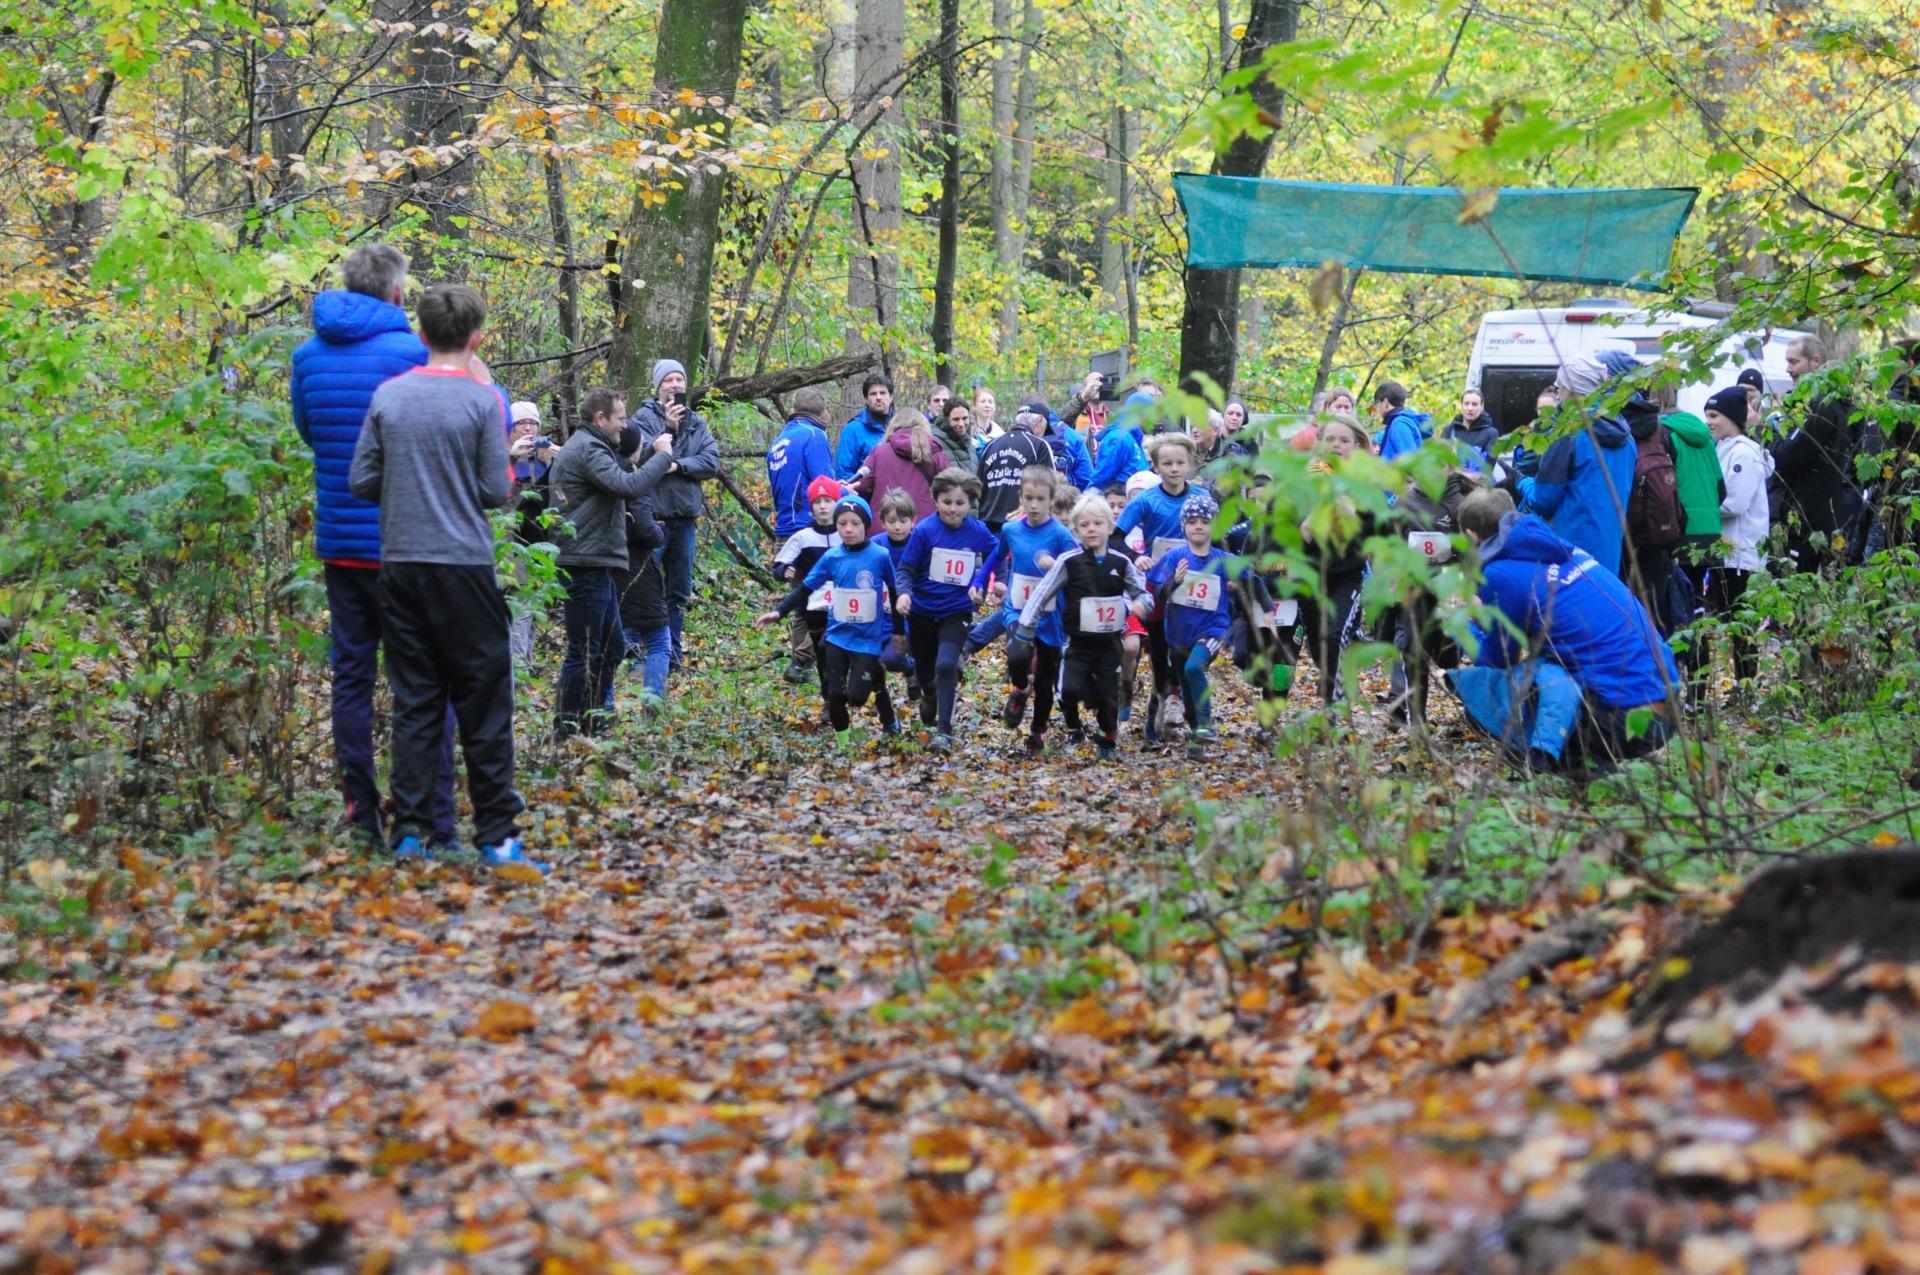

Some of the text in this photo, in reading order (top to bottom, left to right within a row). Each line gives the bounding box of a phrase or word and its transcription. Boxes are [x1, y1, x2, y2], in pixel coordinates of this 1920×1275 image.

[985, 452, 998, 466] Wir
[1424, 541, 1434, 555] 8
[945, 559, 965, 575] 10
[824, 590, 832, 603] 4
[1187, 581, 1208, 599] 13
[849, 598, 860, 613] 9
[1096, 607, 1116, 622] 12
